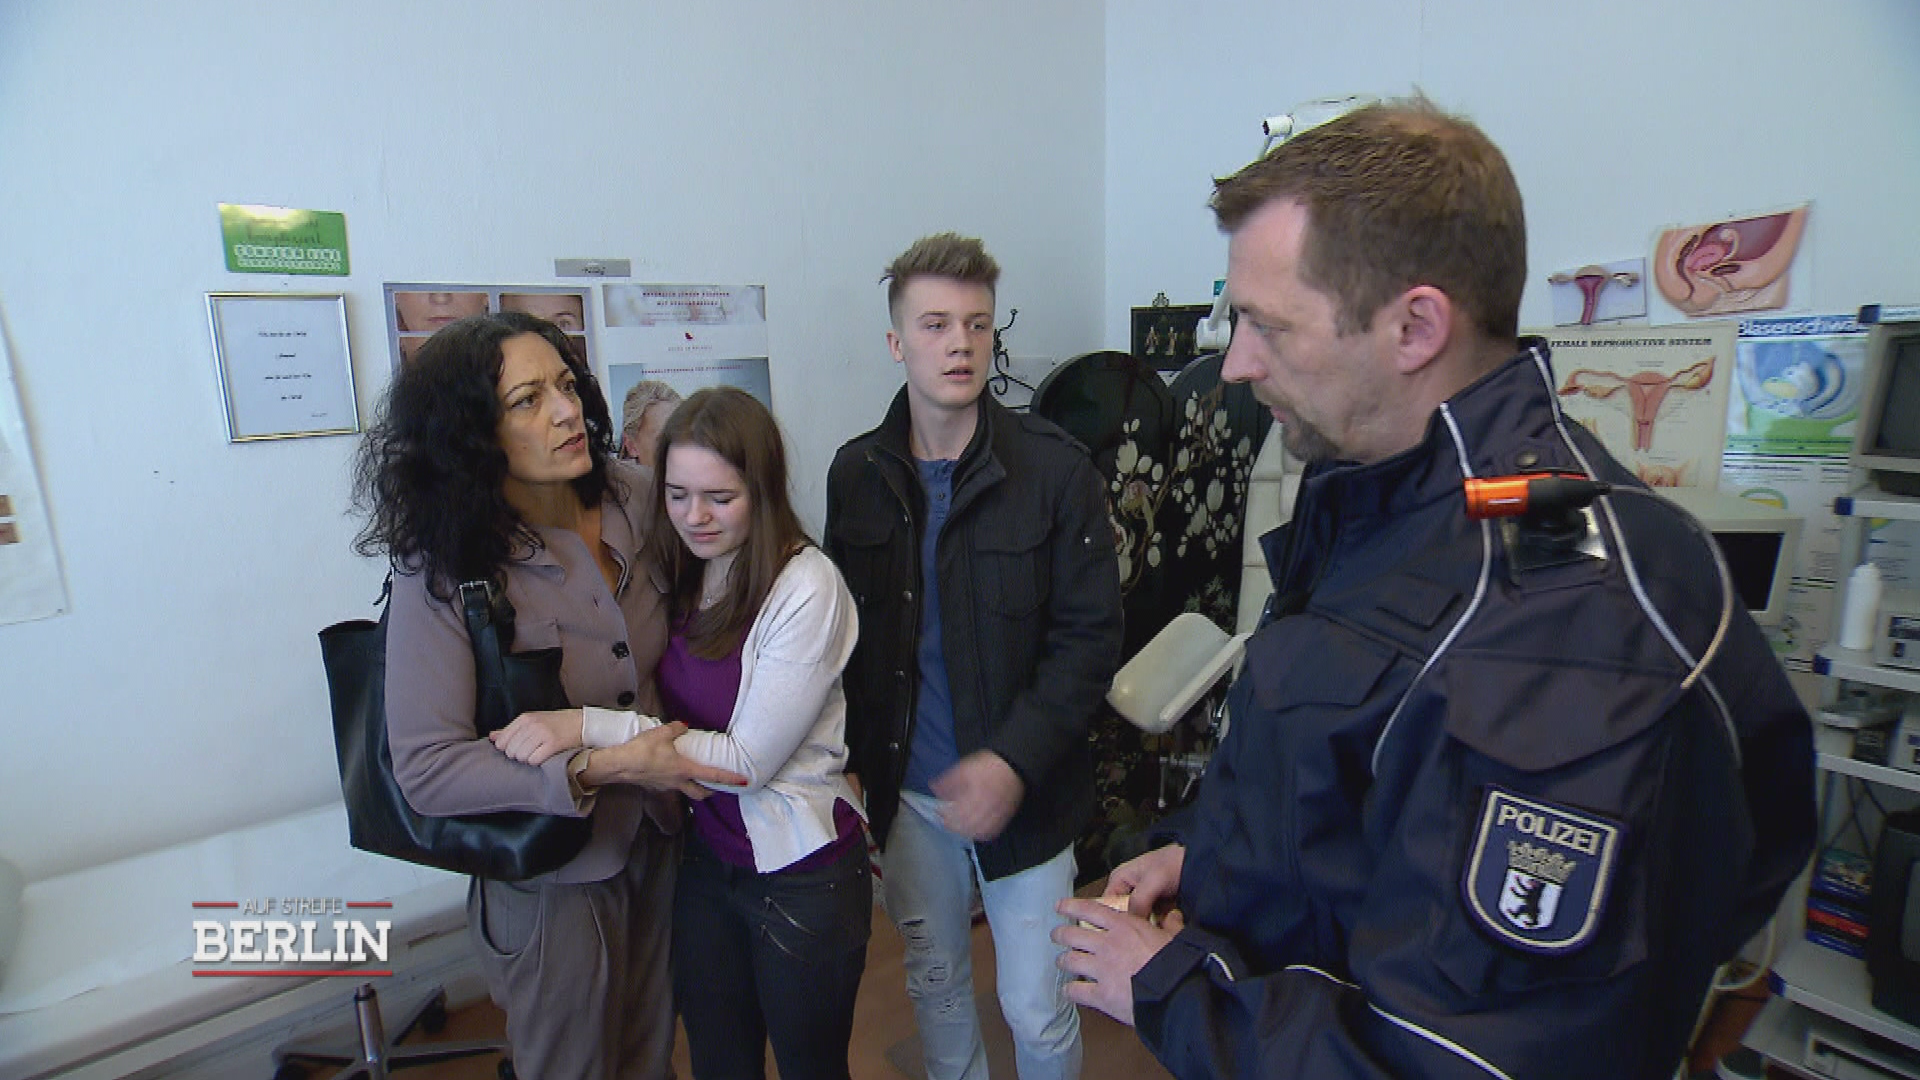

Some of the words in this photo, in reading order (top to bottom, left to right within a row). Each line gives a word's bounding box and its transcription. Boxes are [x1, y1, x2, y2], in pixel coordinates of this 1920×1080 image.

[1551, 340, 1588, 348] FEMALE
[1591, 338, 1667, 348] REPRODUCTIVE
[1668, 337, 1712, 346] SYSTEM
[1497, 804, 1601, 856] POLIZEI
